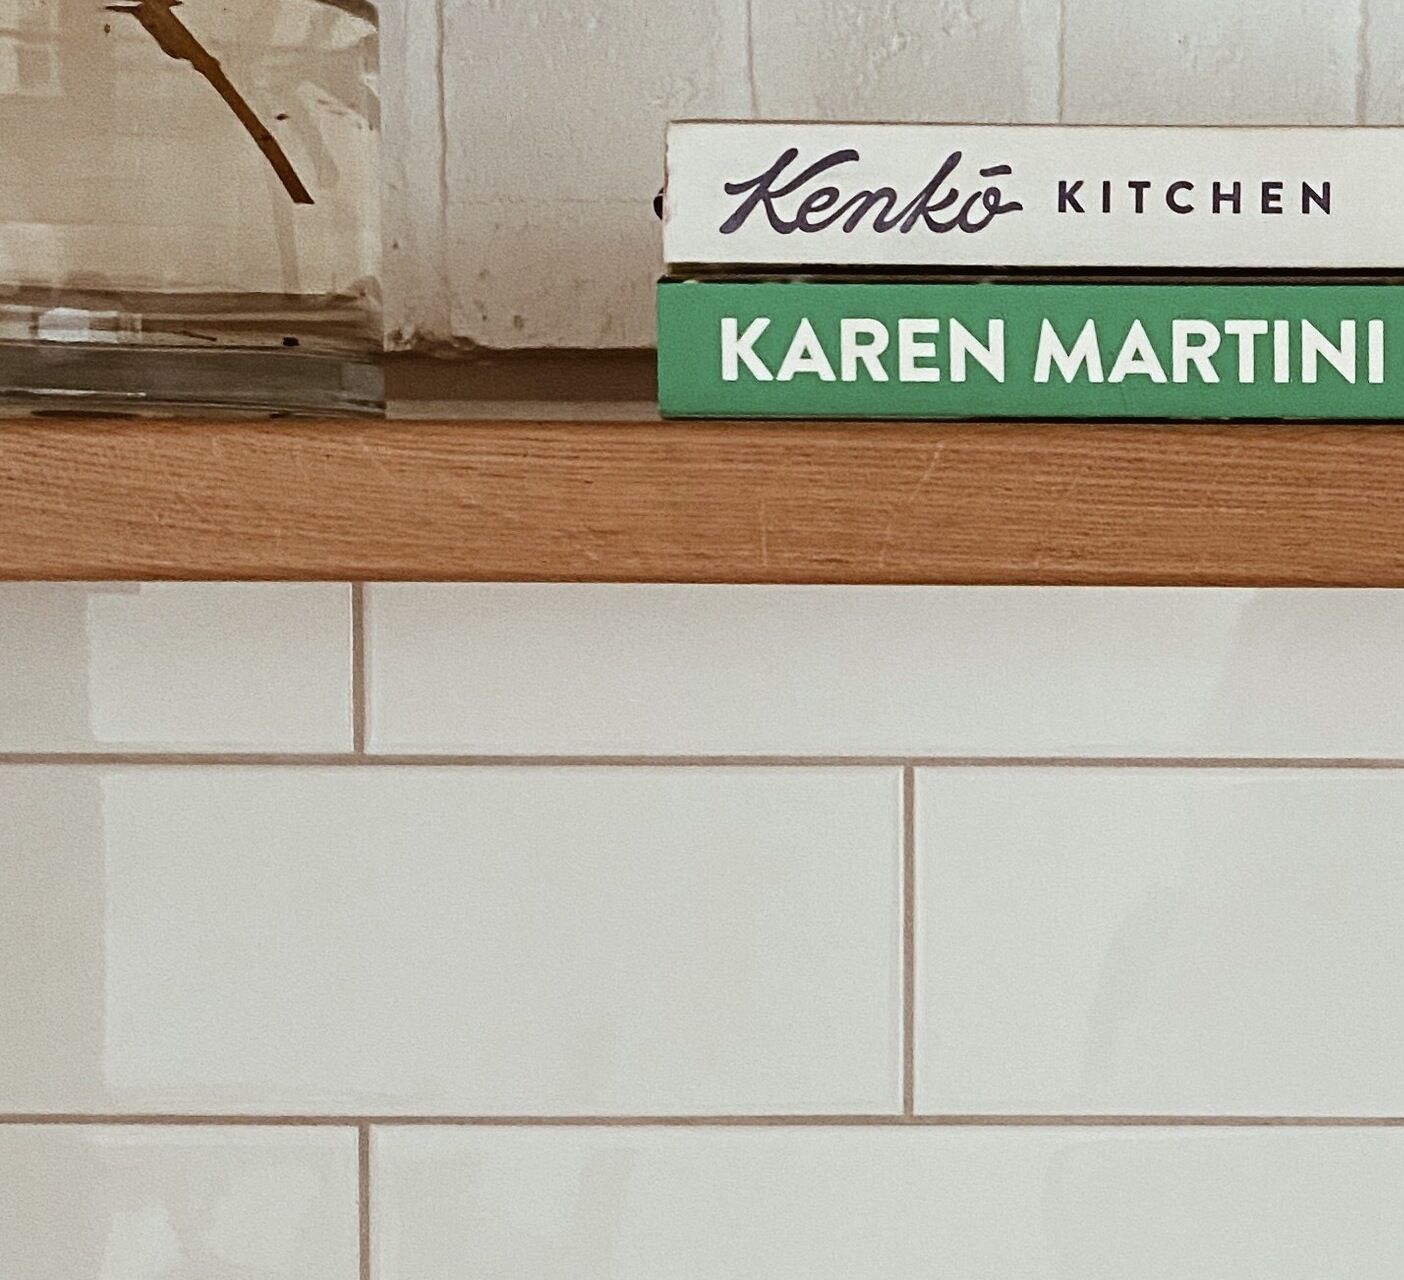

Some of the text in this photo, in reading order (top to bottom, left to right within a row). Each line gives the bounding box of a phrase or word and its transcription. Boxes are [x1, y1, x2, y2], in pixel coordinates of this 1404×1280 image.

[717, 146, 1332, 236] Kenkō KITCHEN
[720, 316, 1006, 384] KAREN
[1032, 317, 1385, 385] MARTINI
